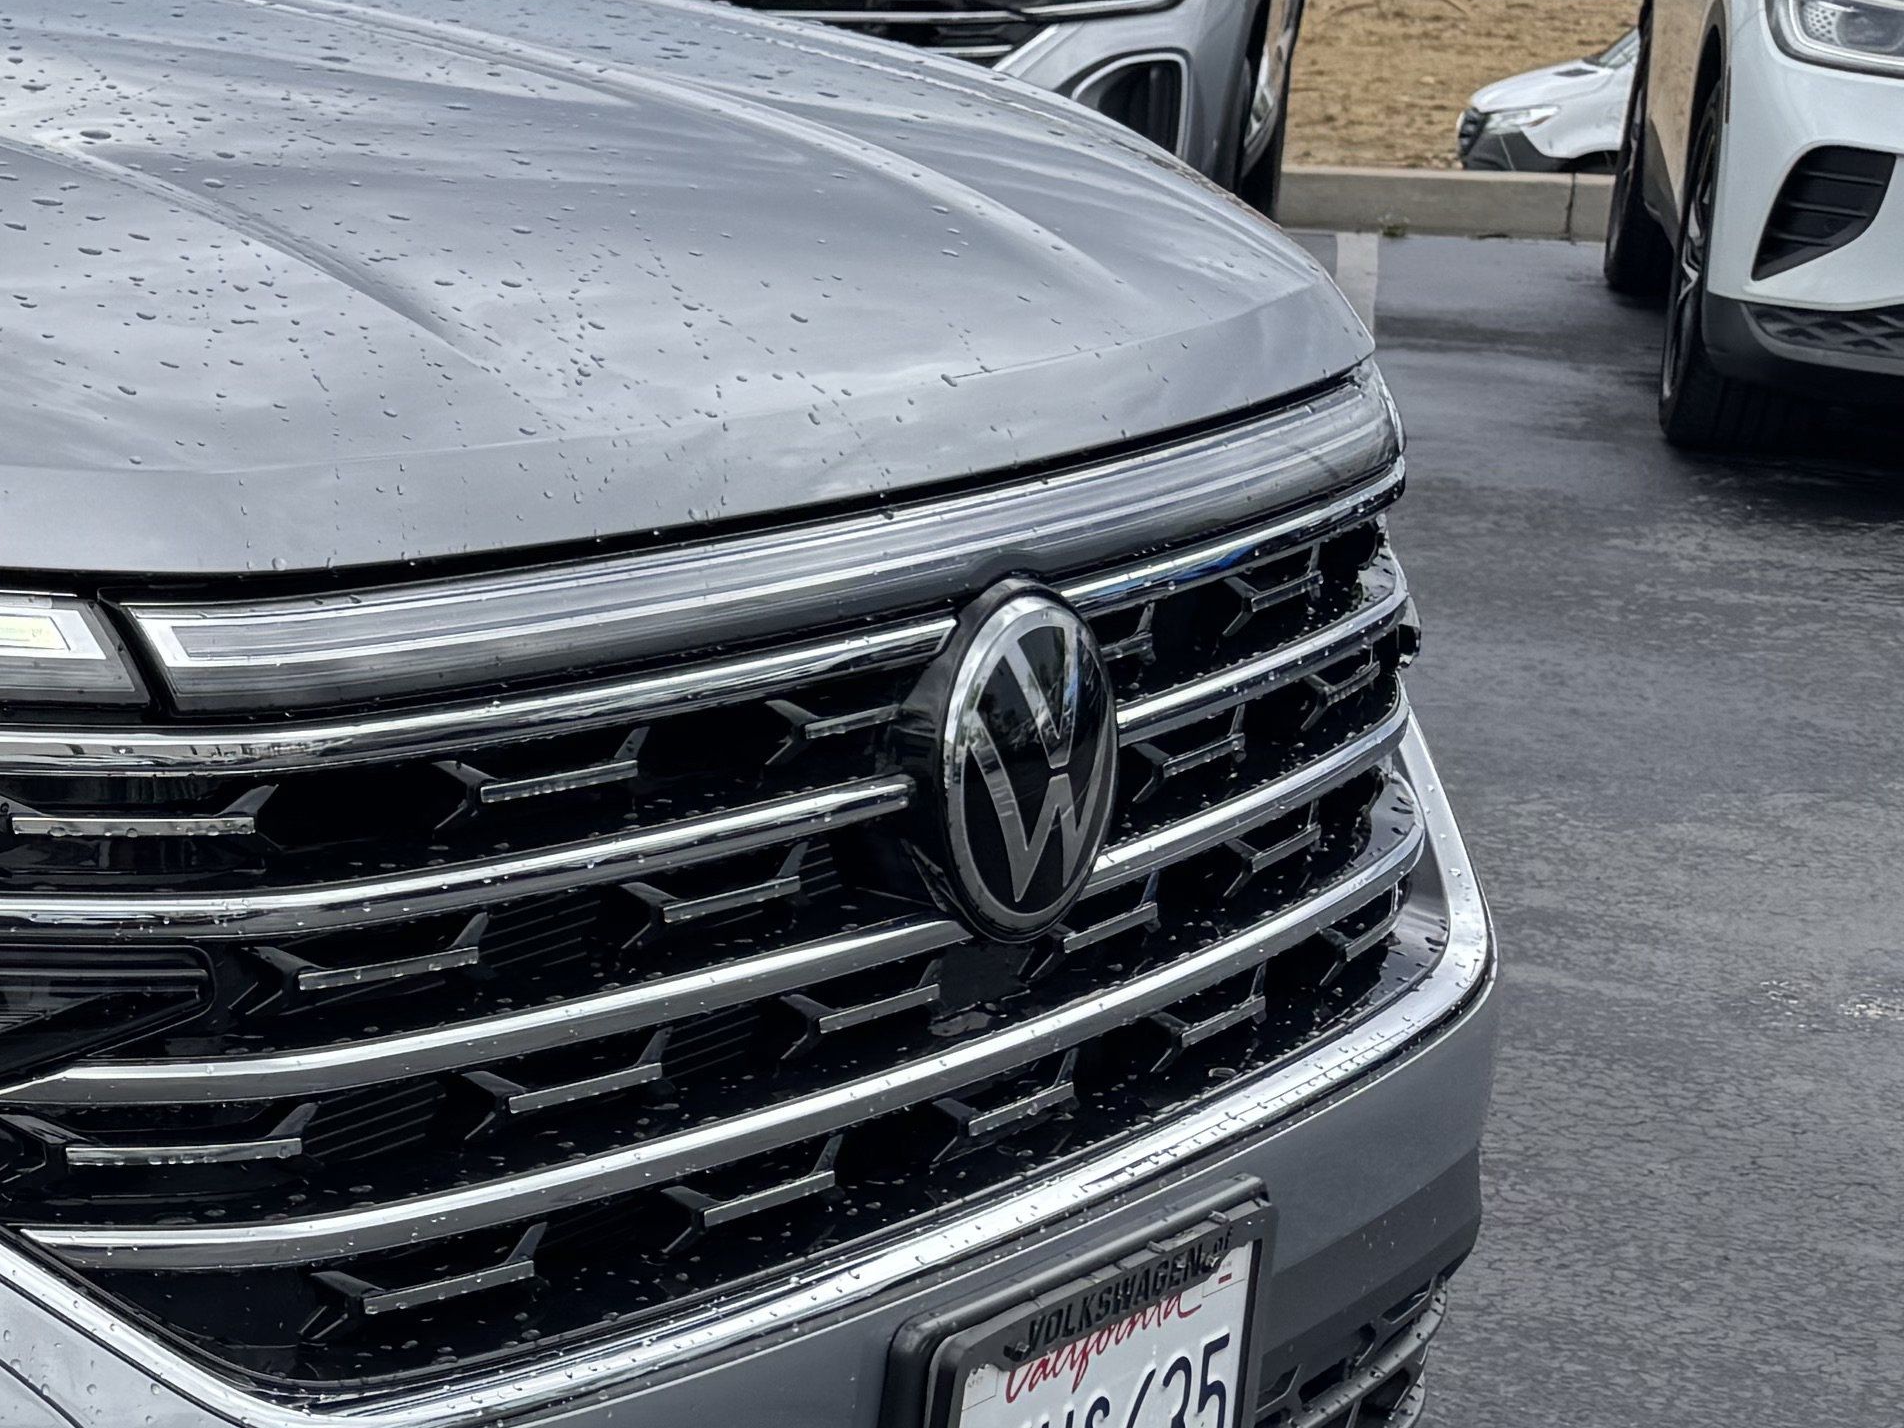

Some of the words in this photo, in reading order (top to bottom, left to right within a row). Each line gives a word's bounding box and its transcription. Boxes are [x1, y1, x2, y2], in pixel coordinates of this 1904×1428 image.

[947, 610, 1116, 914] VW
[1026, 1243, 1204, 1351] VOLKSWAGEN
[1213, 1225, 1233, 1254] of
